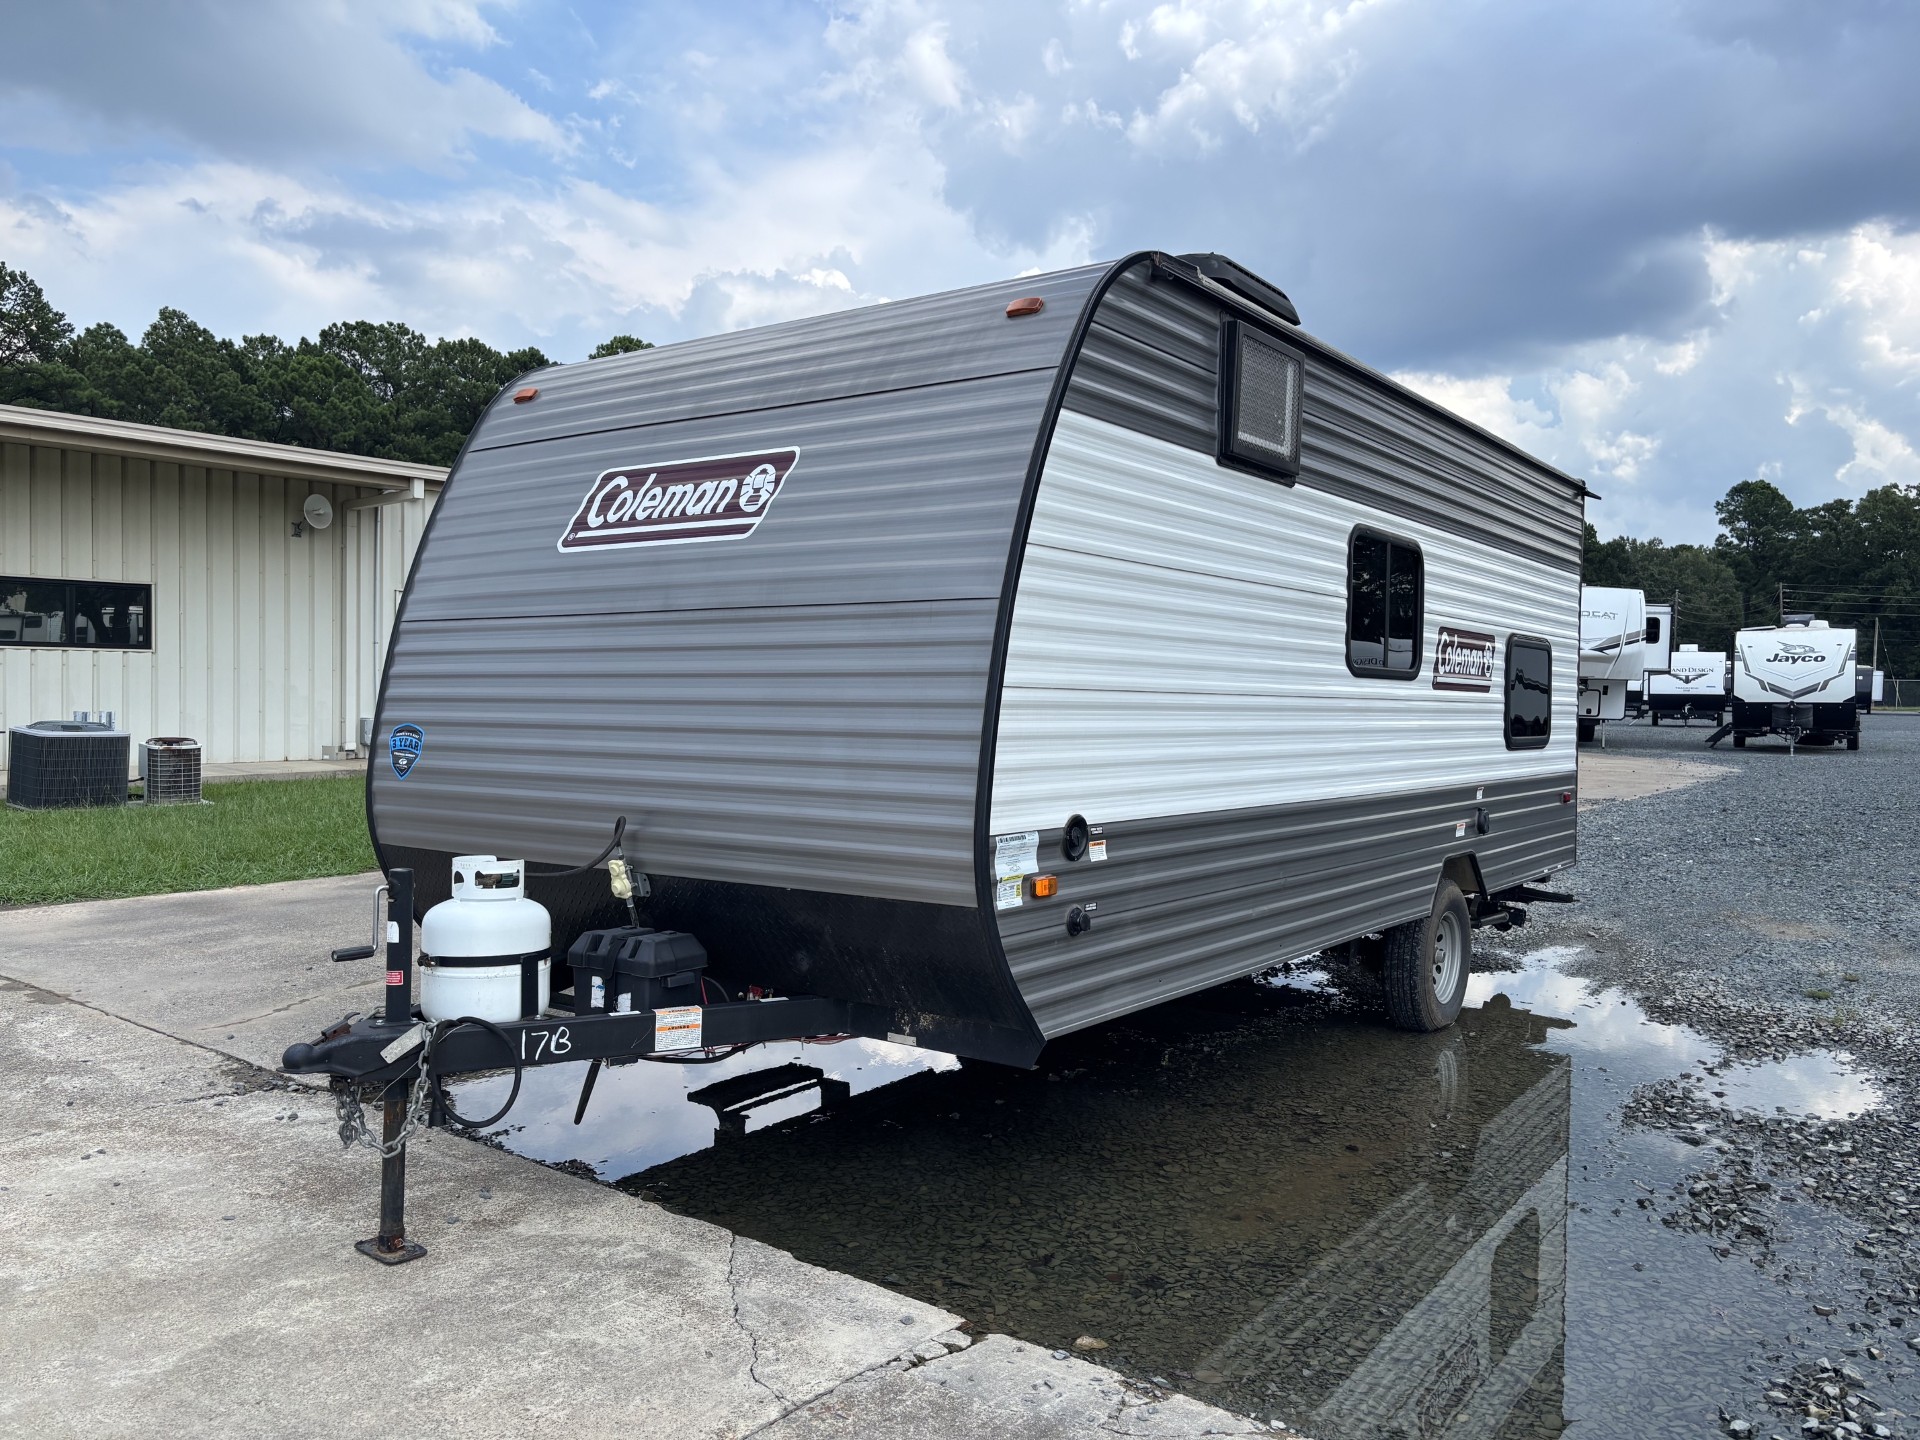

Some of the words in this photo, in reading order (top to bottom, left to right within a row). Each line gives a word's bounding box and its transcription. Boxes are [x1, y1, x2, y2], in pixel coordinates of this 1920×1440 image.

[587, 473, 739, 529] Coleman
[1581, 610, 1619, 621] DCAT
[1438, 631, 1483, 675] Coleman
[1765, 653, 1826, 665] Jayco
[399, 738, 419, 751] YEAR
[521, 1026, 572, 1061] 17B
